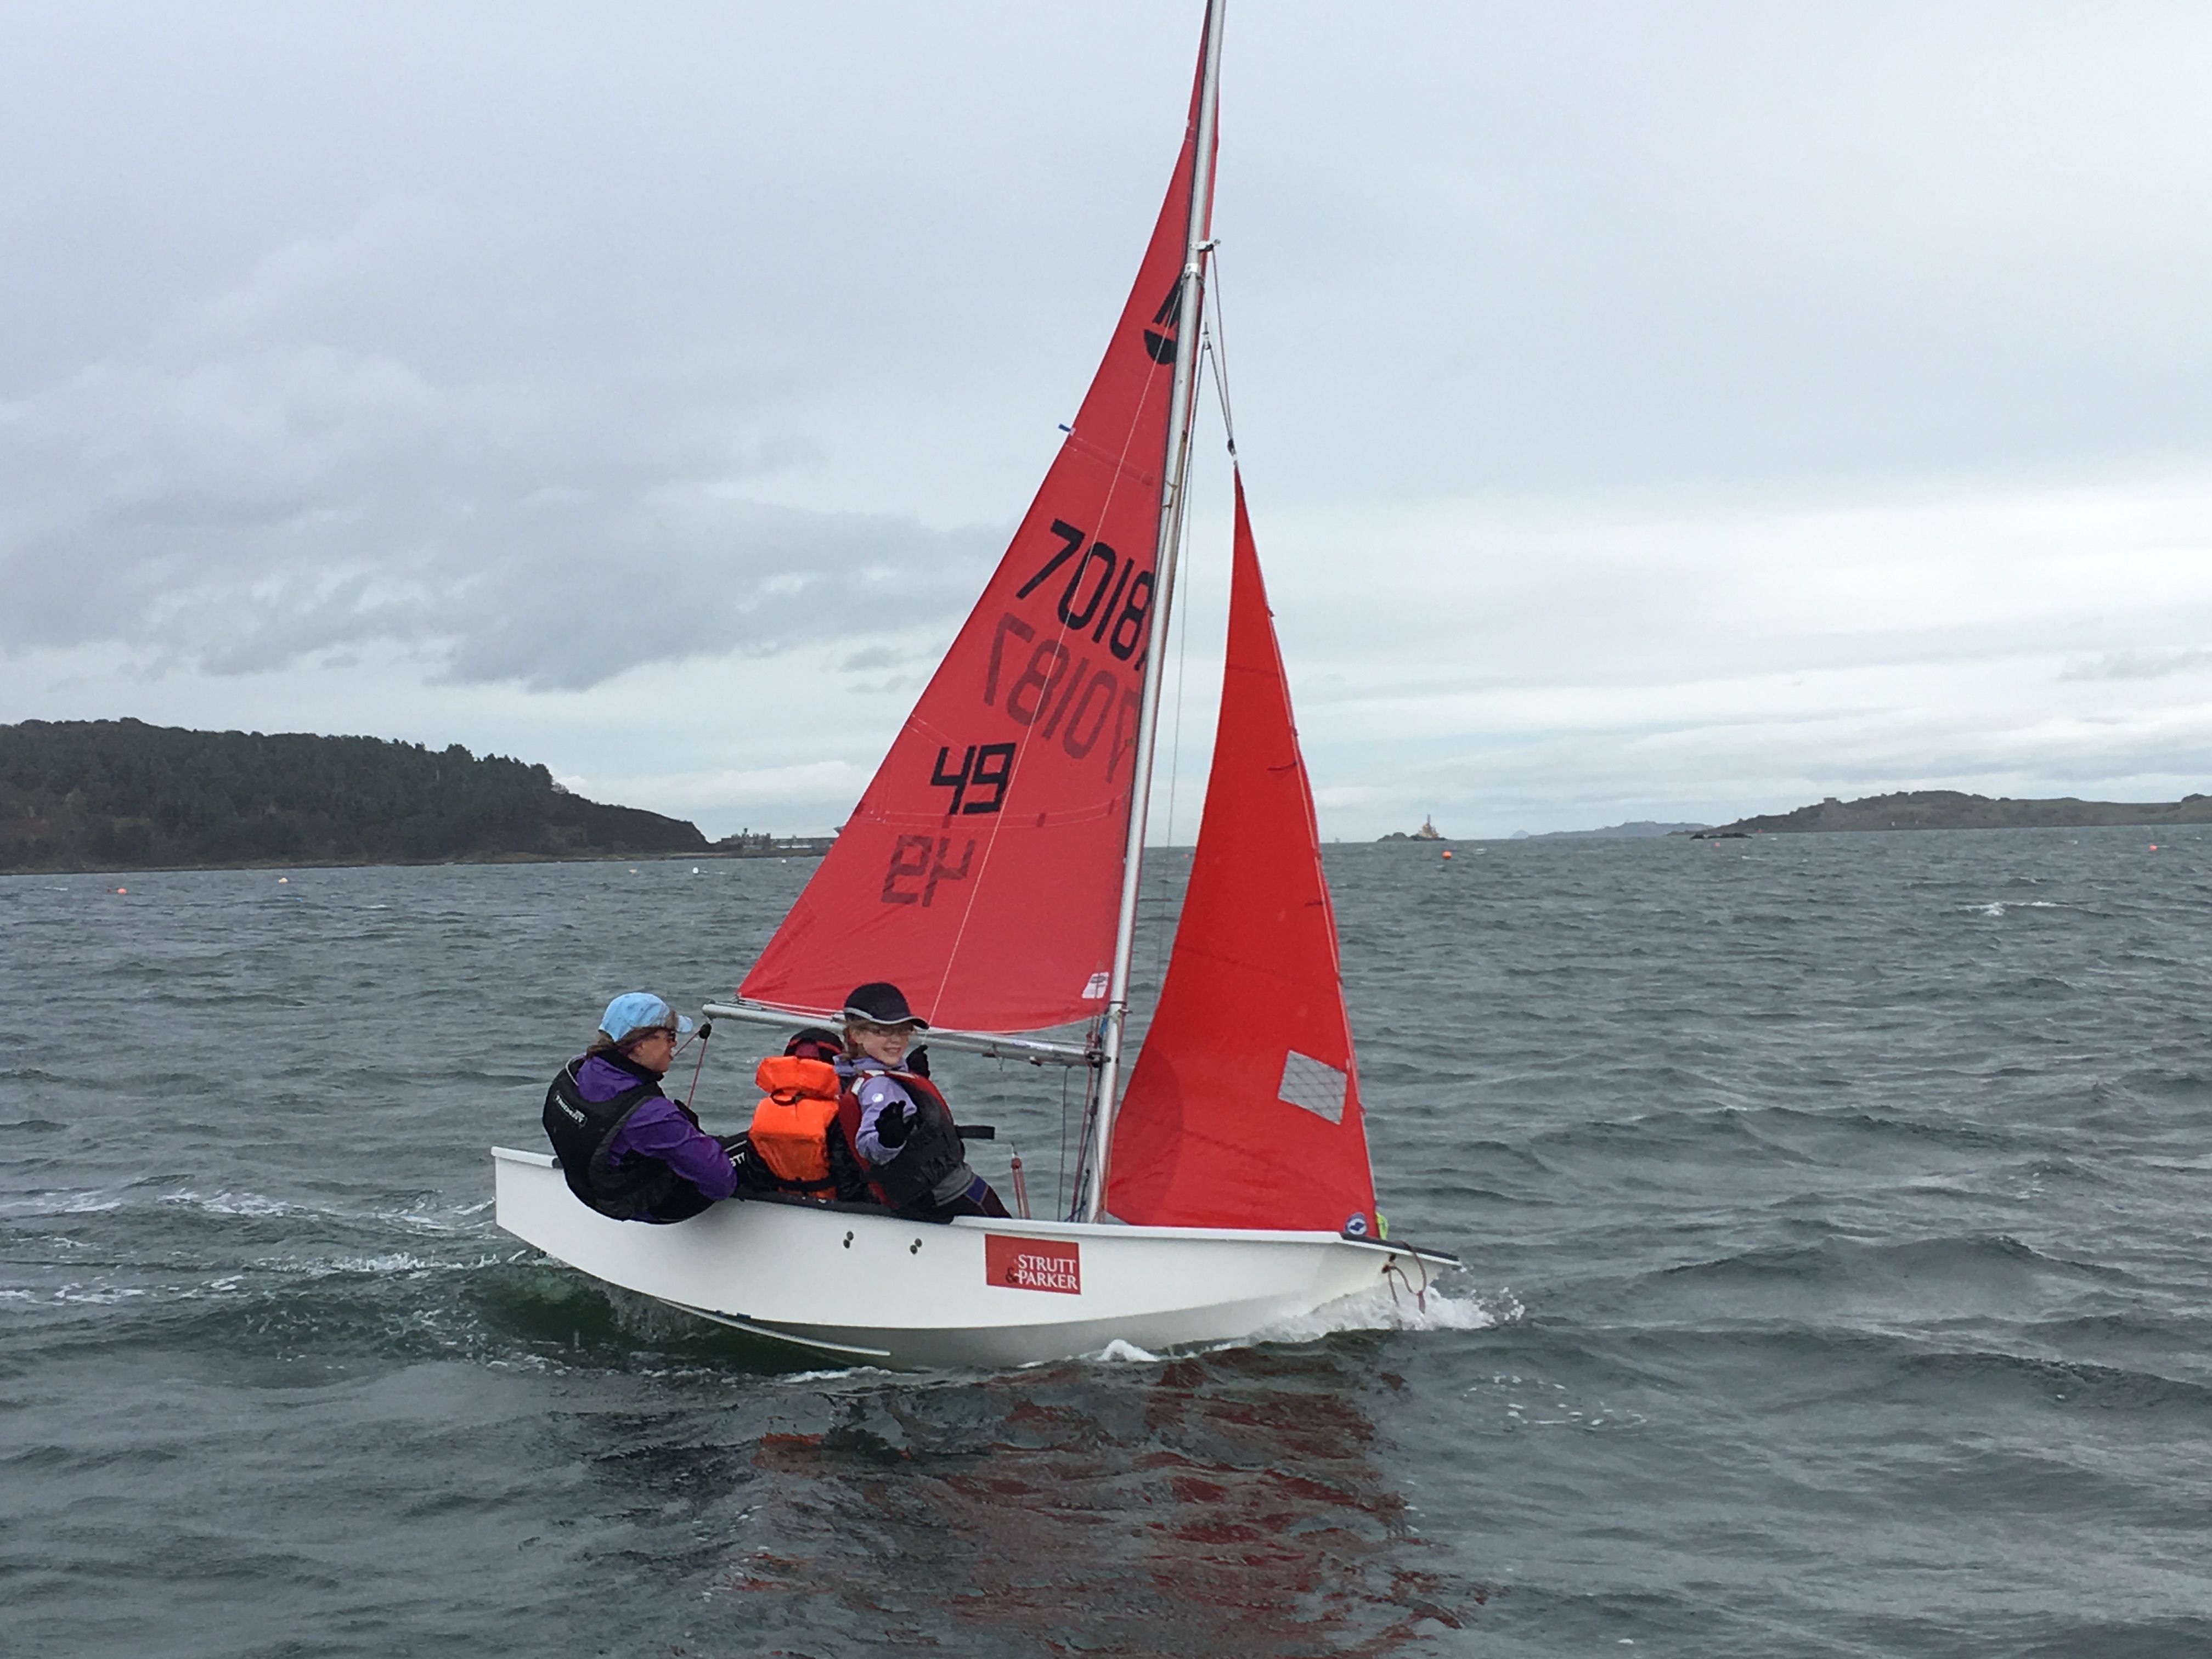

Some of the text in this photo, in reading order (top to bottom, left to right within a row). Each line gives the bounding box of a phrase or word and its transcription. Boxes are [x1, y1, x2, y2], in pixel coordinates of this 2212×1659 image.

[1016, 518, 1154, 670] 7018
[930, 742, 1016, 815] 49
[1018, 1254, 1076, 1273] STRUTT
[1019, 1269, 1078, 1290] PARKER
